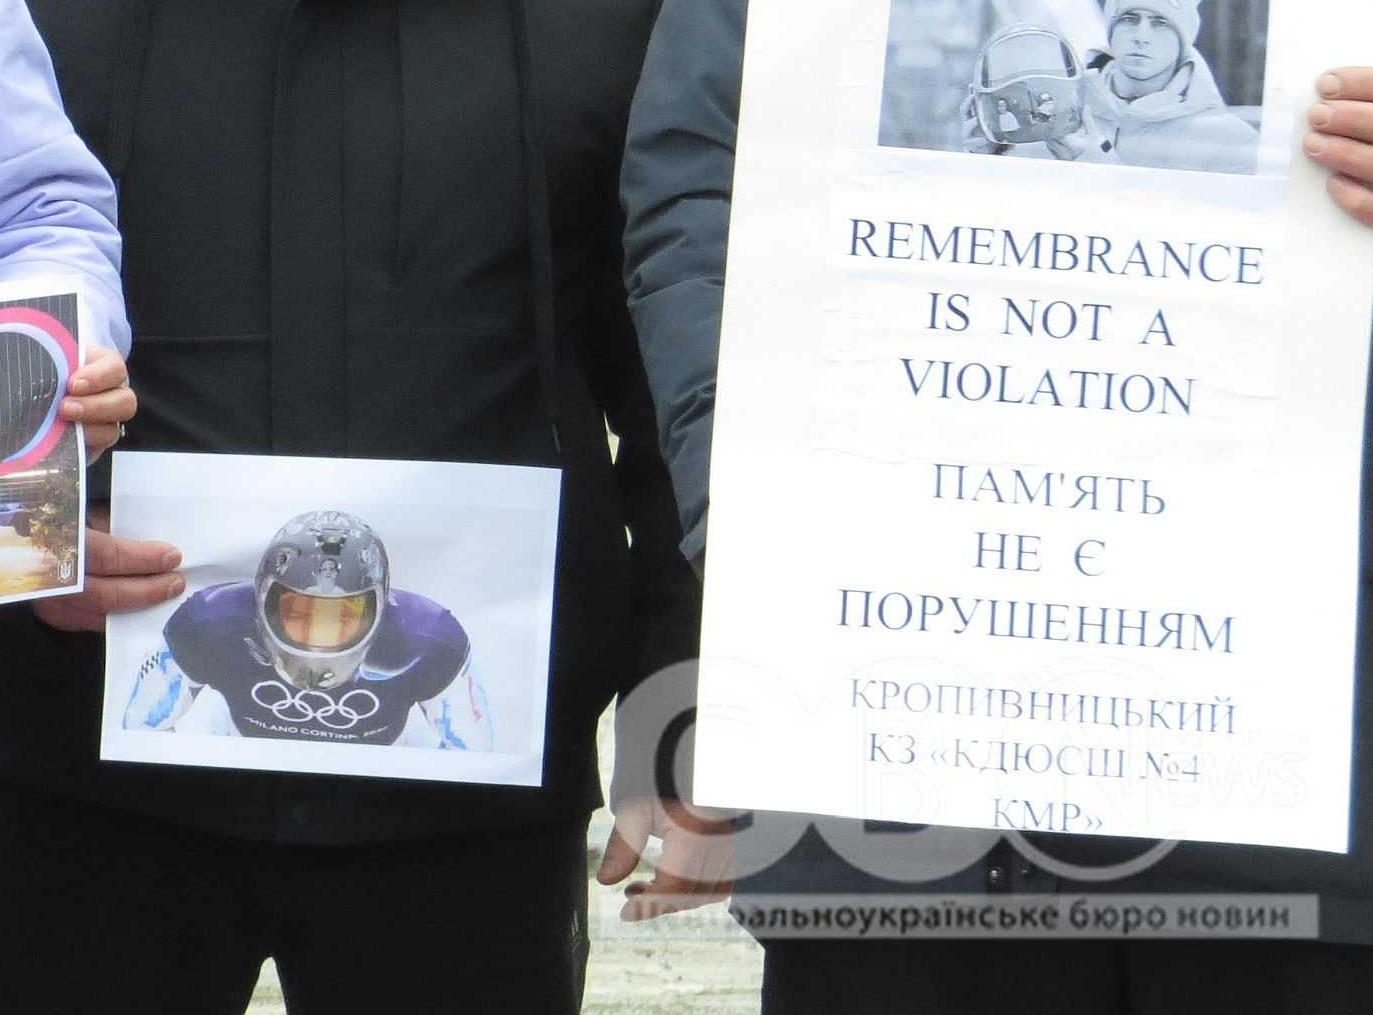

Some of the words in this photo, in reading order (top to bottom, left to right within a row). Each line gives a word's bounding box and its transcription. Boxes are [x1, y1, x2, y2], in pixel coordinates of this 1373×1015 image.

[847, 218, 1265, 285] REMEMBRANCE
[926, 291, 971, 332] IS
[1001, 297, 1113, 341] NOT
[1139, 308, 1177, 347] A
[898, 357, 1198, 416] VIOLATION
[933, 463, 1167, 516] ПАМ'ЯТЬ
[973, 531, 1043, 573] НЕ
[1073, 539, 1107, 577] Є
[836, 588, 1238, 654] ПОРУШЕННЯМ
[850, 677, 1238, 735] КРОПИВНИЦЬКИЙ
[869, 732, 917, 766] КЗ
[930, 738, 1126, 778] «КДЮСШ
[1139, 750, 1202, 783] №4
[992, 798, 1104, 833] КМР»
